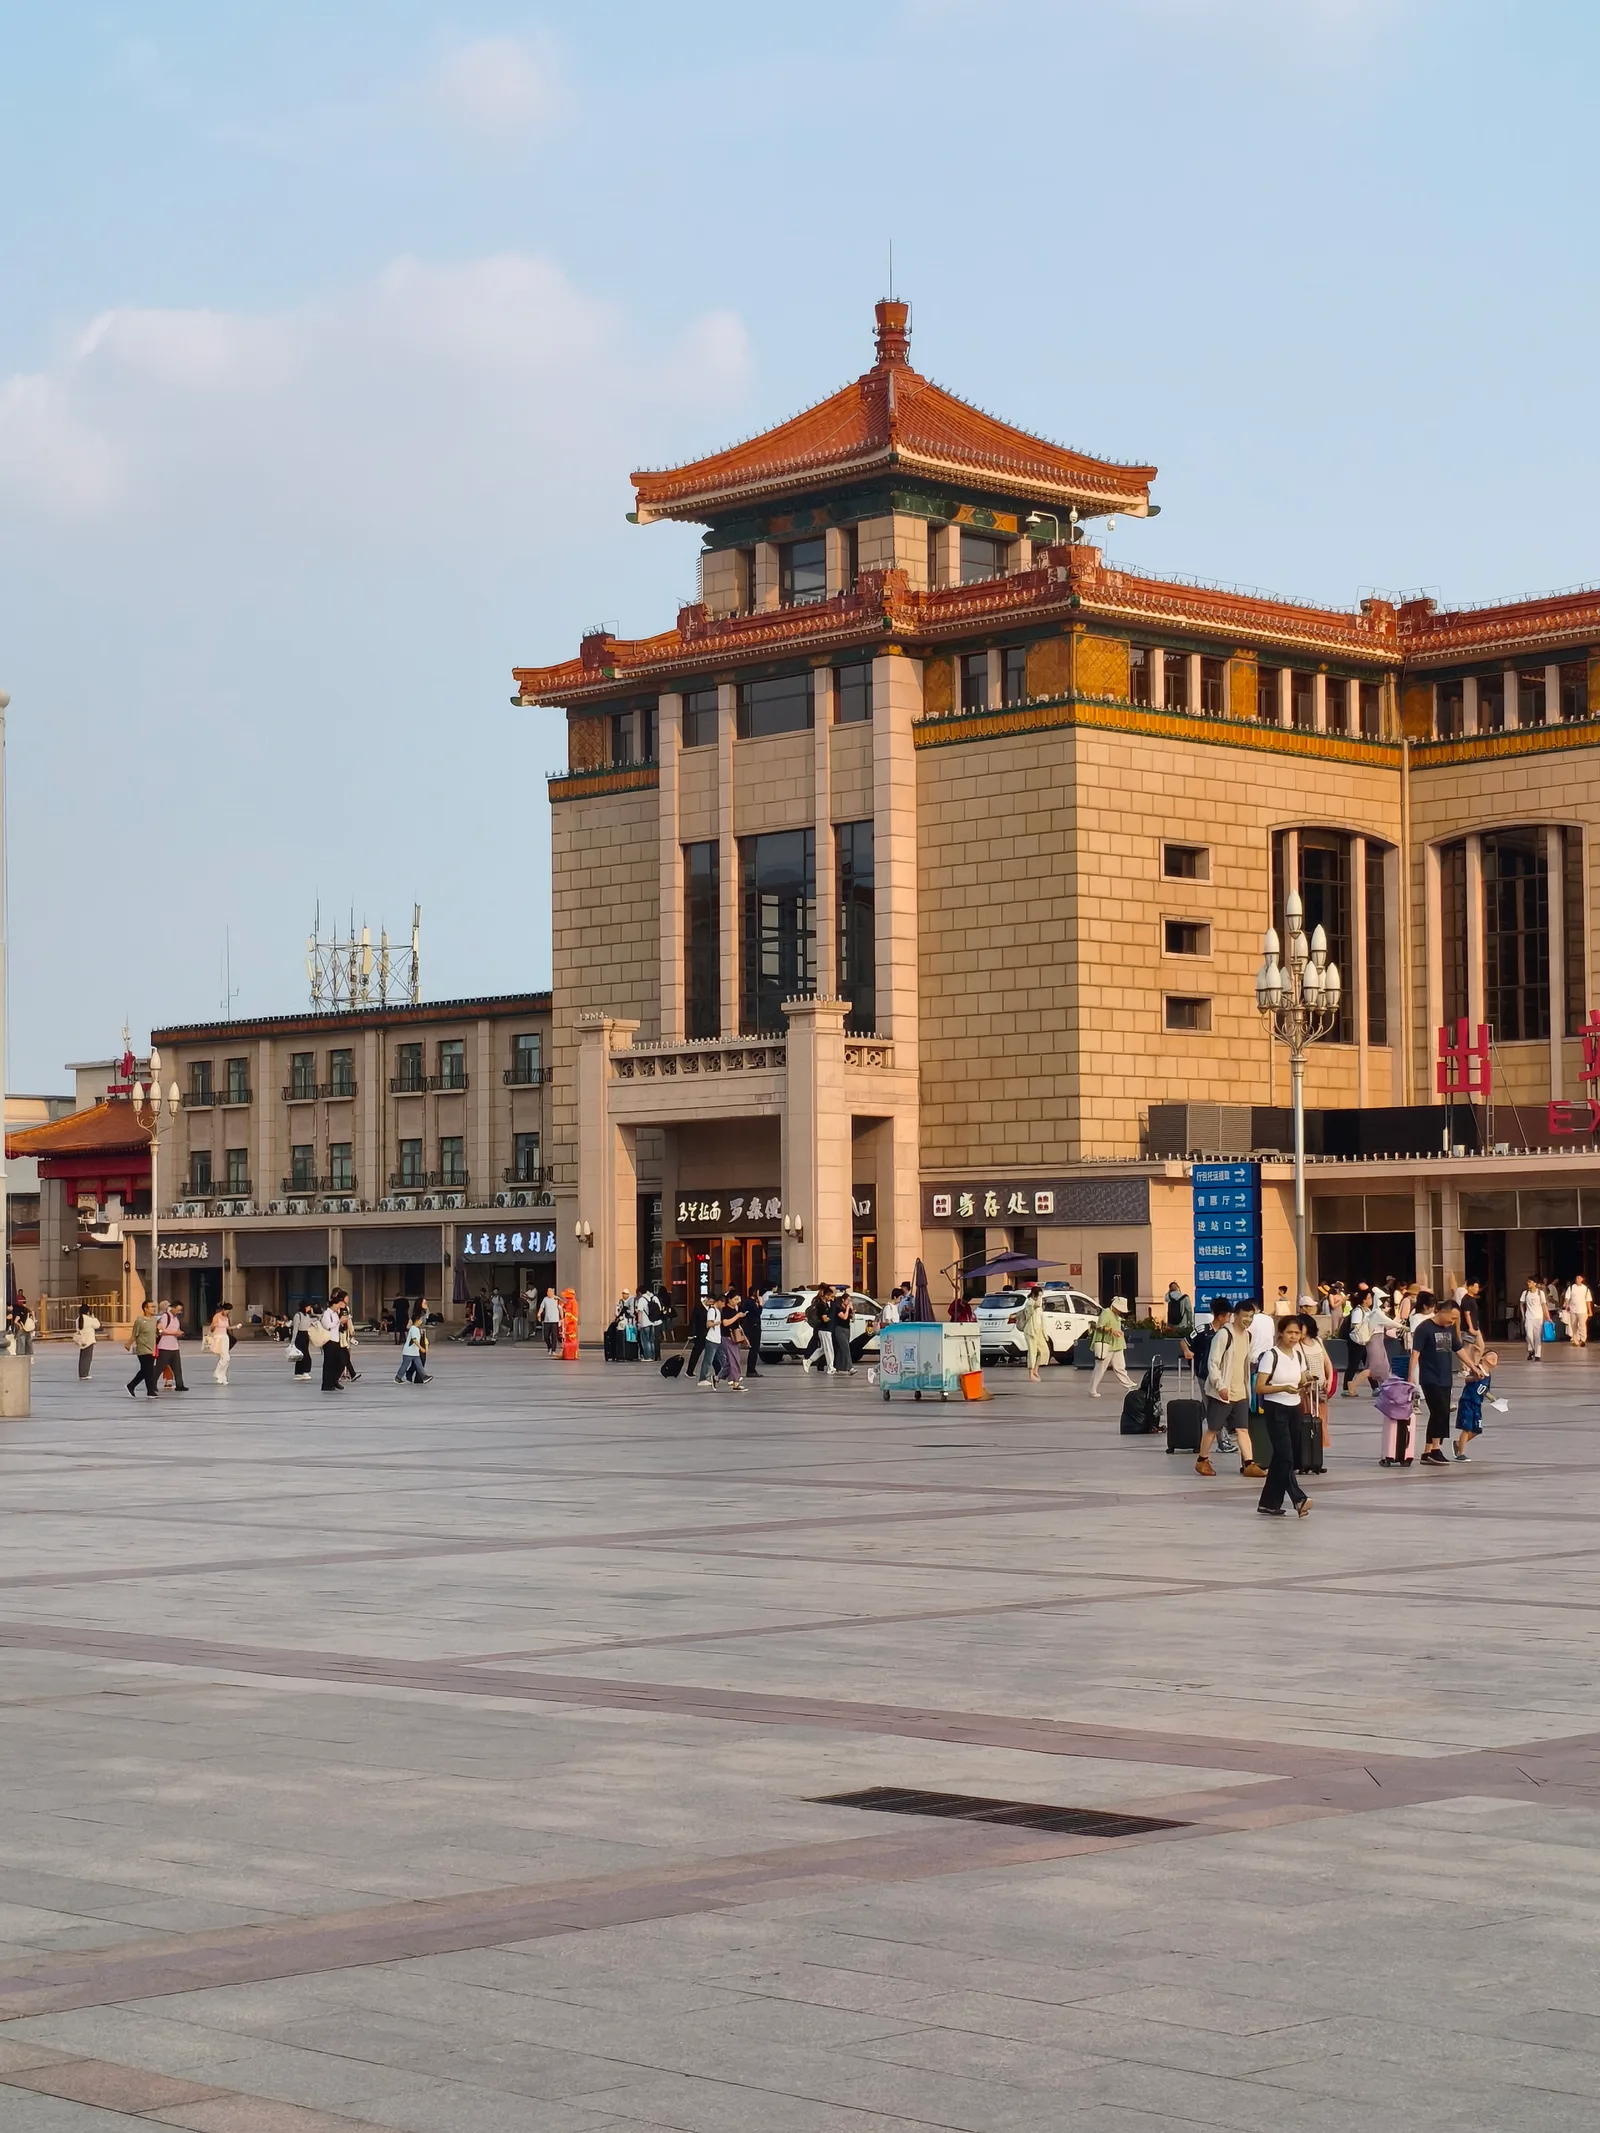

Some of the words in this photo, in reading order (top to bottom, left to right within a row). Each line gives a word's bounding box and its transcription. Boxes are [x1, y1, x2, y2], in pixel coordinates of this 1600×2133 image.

[956, 1190, 1030, 1217] 寄存处
[677, 1200, 721, 1222] 马兰拉面
[1197, 1220, 1231, 1232] 进站口
[463, 1230, 556, 1254] 美宜佳便利店
[1198, 1245, 1232, 1256] 地铁进站口
[1198, 1270, 1232, 1280] 出租车调度站
[1055, 1320, 1072, 1331] 公安
